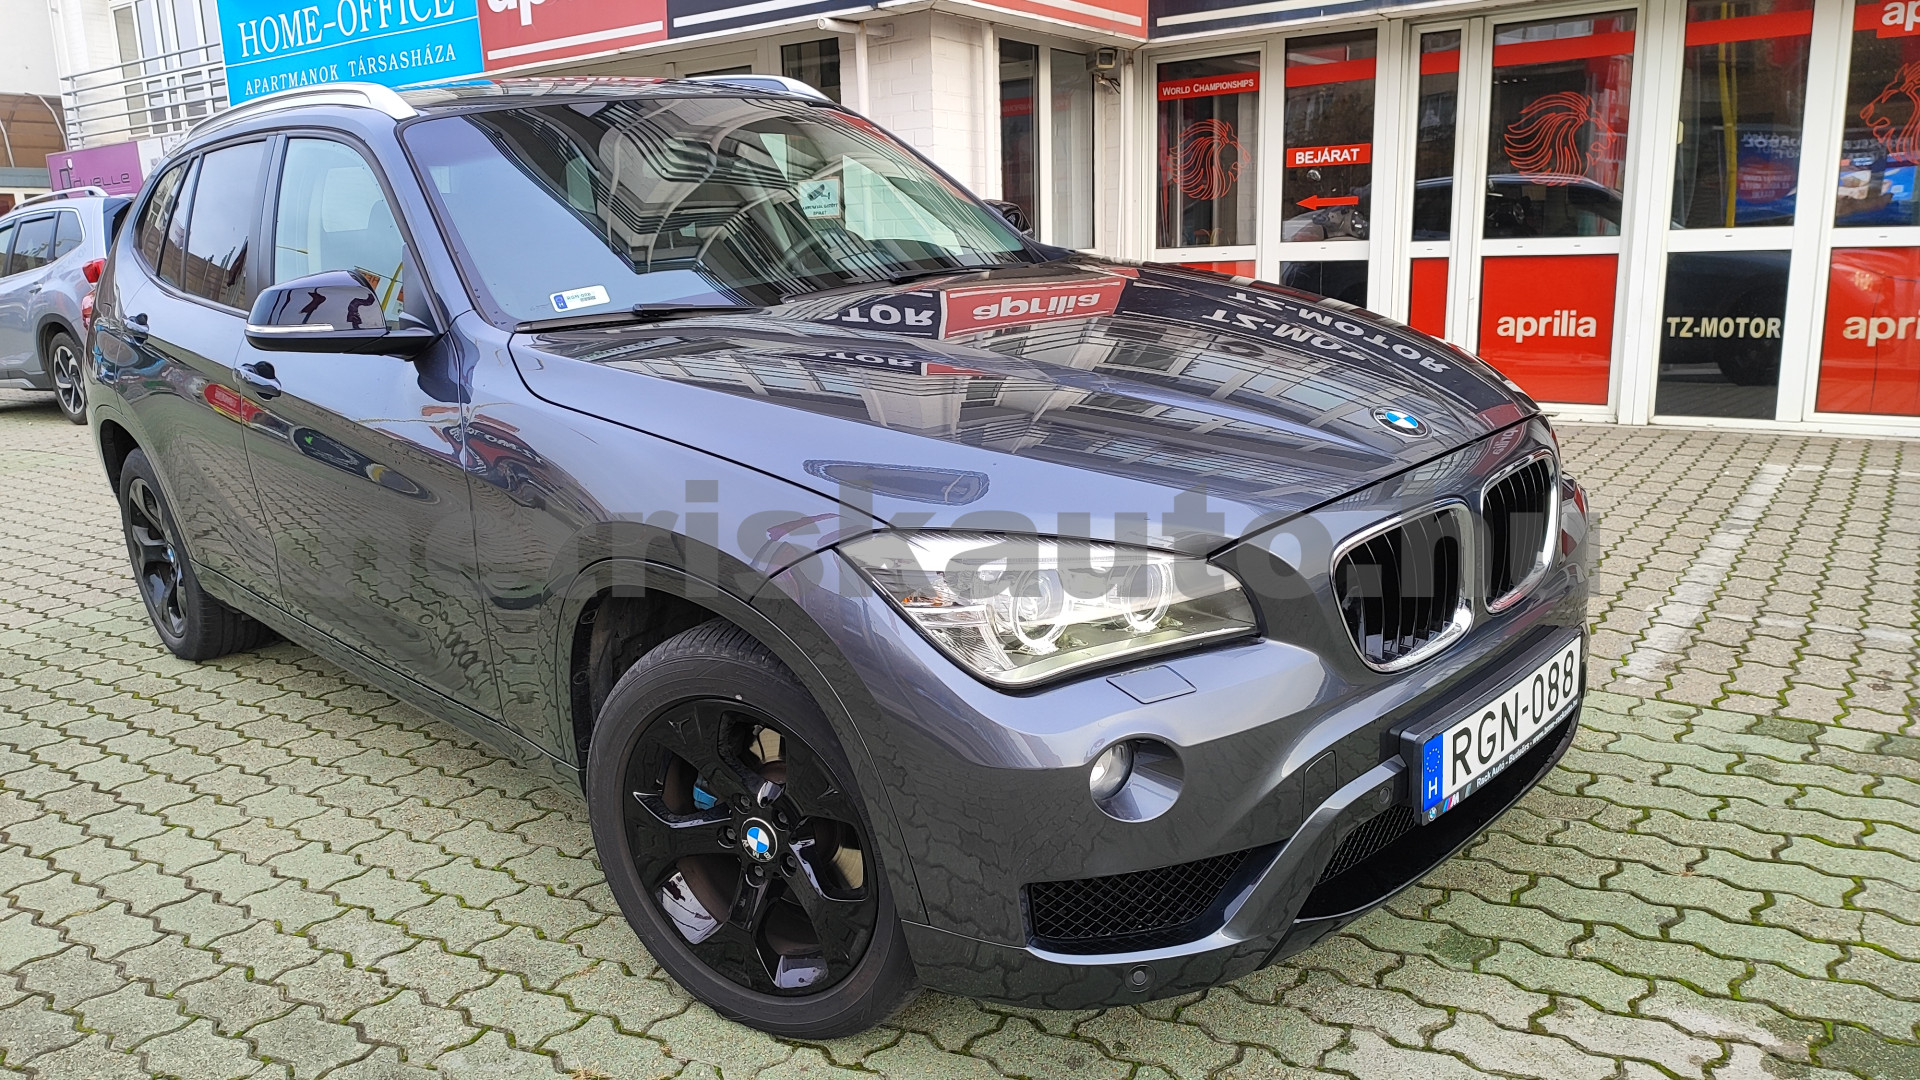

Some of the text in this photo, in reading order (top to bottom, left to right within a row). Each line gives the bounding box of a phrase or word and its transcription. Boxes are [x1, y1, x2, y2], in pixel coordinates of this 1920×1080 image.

[245, 43, 456, 96] APARTMANOK TÁRSASHÁZA
[1295, 147, 1360, 165] BEJÁRAT
[1496, 310, 1597, 343] aprilia
[1667, 316, 1781, 339] TZ-MOTOR
[1428, 649, 1575, 800] H RGN-088
